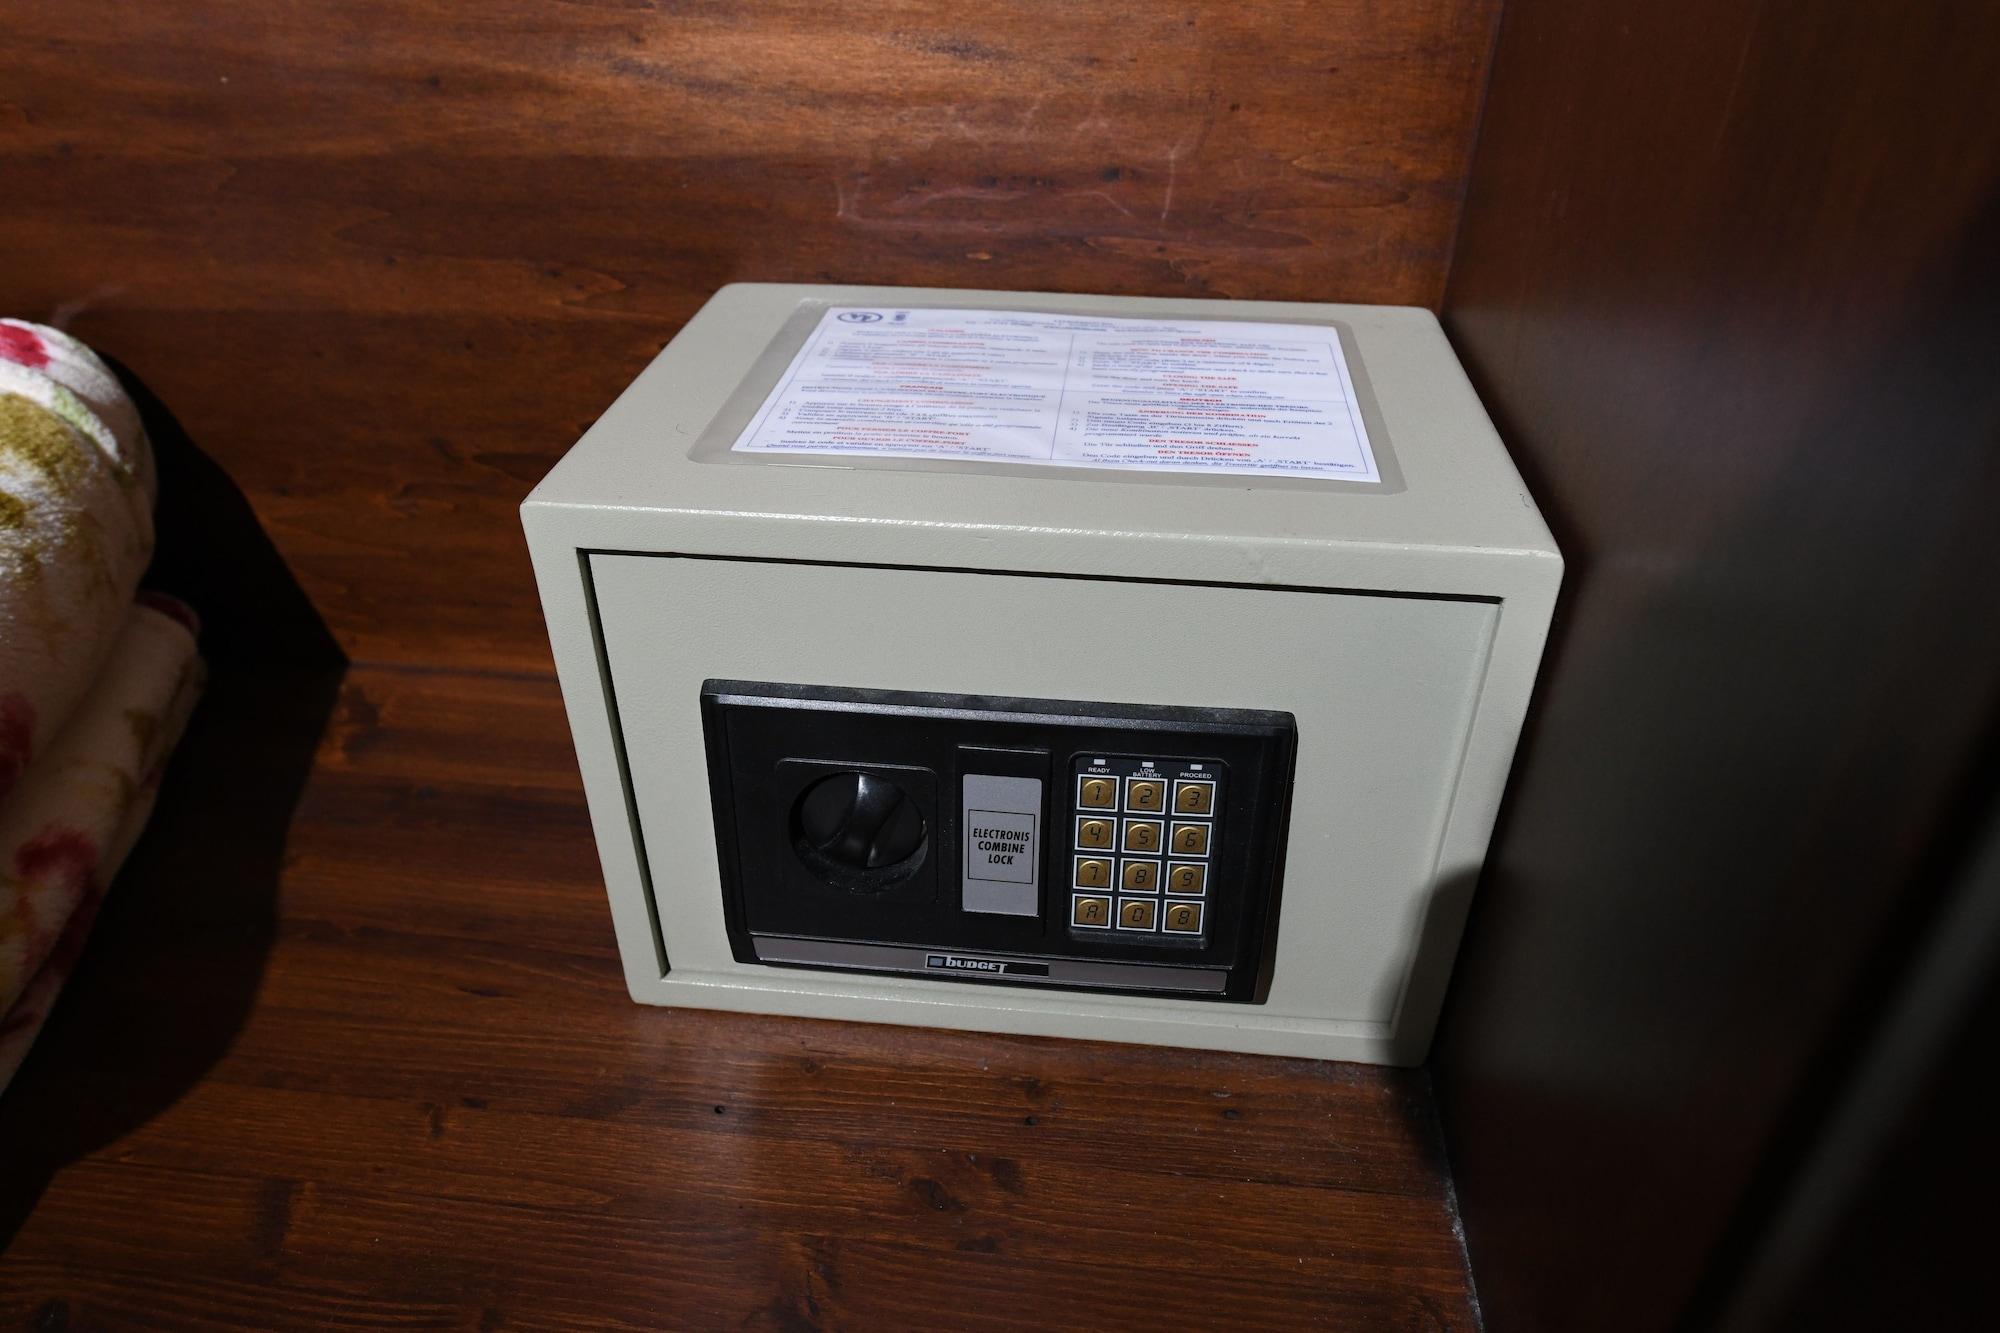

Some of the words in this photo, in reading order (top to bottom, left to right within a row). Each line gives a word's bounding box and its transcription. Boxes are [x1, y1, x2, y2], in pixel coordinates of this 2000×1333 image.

[1095, 785, 1101, 801] 1
[1140, 788, 1152, 804] 2
[1188, 791, 1200, 807] 3
[973, 828, 1030, 842] ELECTRONIS
[1090, 827, 1102, 842] 4
[1139, 829, 1150, 845] 5
[1185, 832, 1197, 848] 6
[978, 841, 1025, 854] COMBINE
[988, 855, 1013, 865] LOCK
[1090, 866, 1099, 880] 7
[1134, 869, 1147, 884] 8
[1182, 871, 1194, 887] 9
[1086, 904, 1098, 919] A
